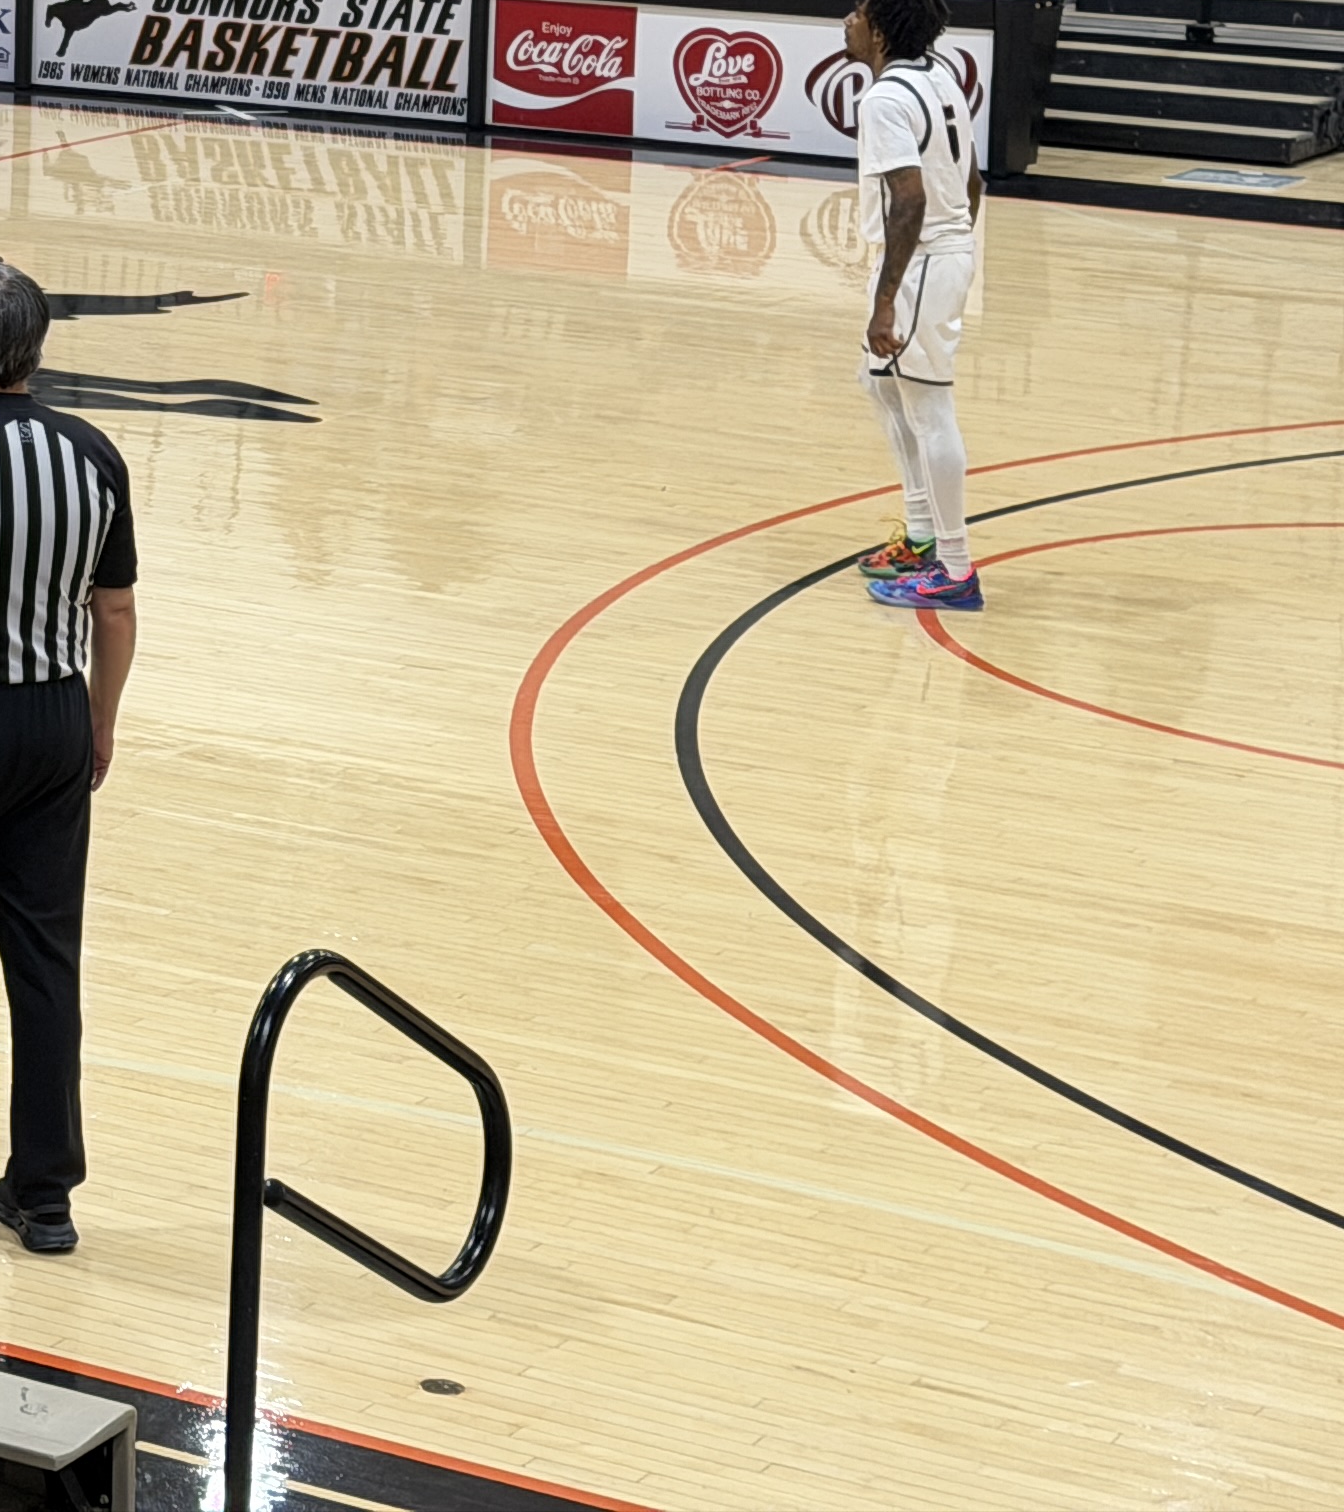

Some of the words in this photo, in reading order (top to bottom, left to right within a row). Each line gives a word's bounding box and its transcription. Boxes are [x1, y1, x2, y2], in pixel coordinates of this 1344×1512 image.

[542, 22, 572, 37] Enjoy
[129, 14, 464, 93] BASKETBALL
[506, 30, 628, 78] Coca-Cola
[689, 42, 755, 86] Love
[38, 60, 65, 80] 1985
[70, 64, 120, 85] WOMENS
[124, 68, 178, 90] NATIONAL
[184, 74, 254, 96] CHAMPIONS
[262, 80, 290, 100] 1990
[294, 83, 326, 104] MENS
[330, 86, 388, 110] NATIONAL
[394, 92, 467, 116] CHAMPIONS
[696, 86, 742, 100] BOTTLING
[745, 89, 762, 100] CO.
